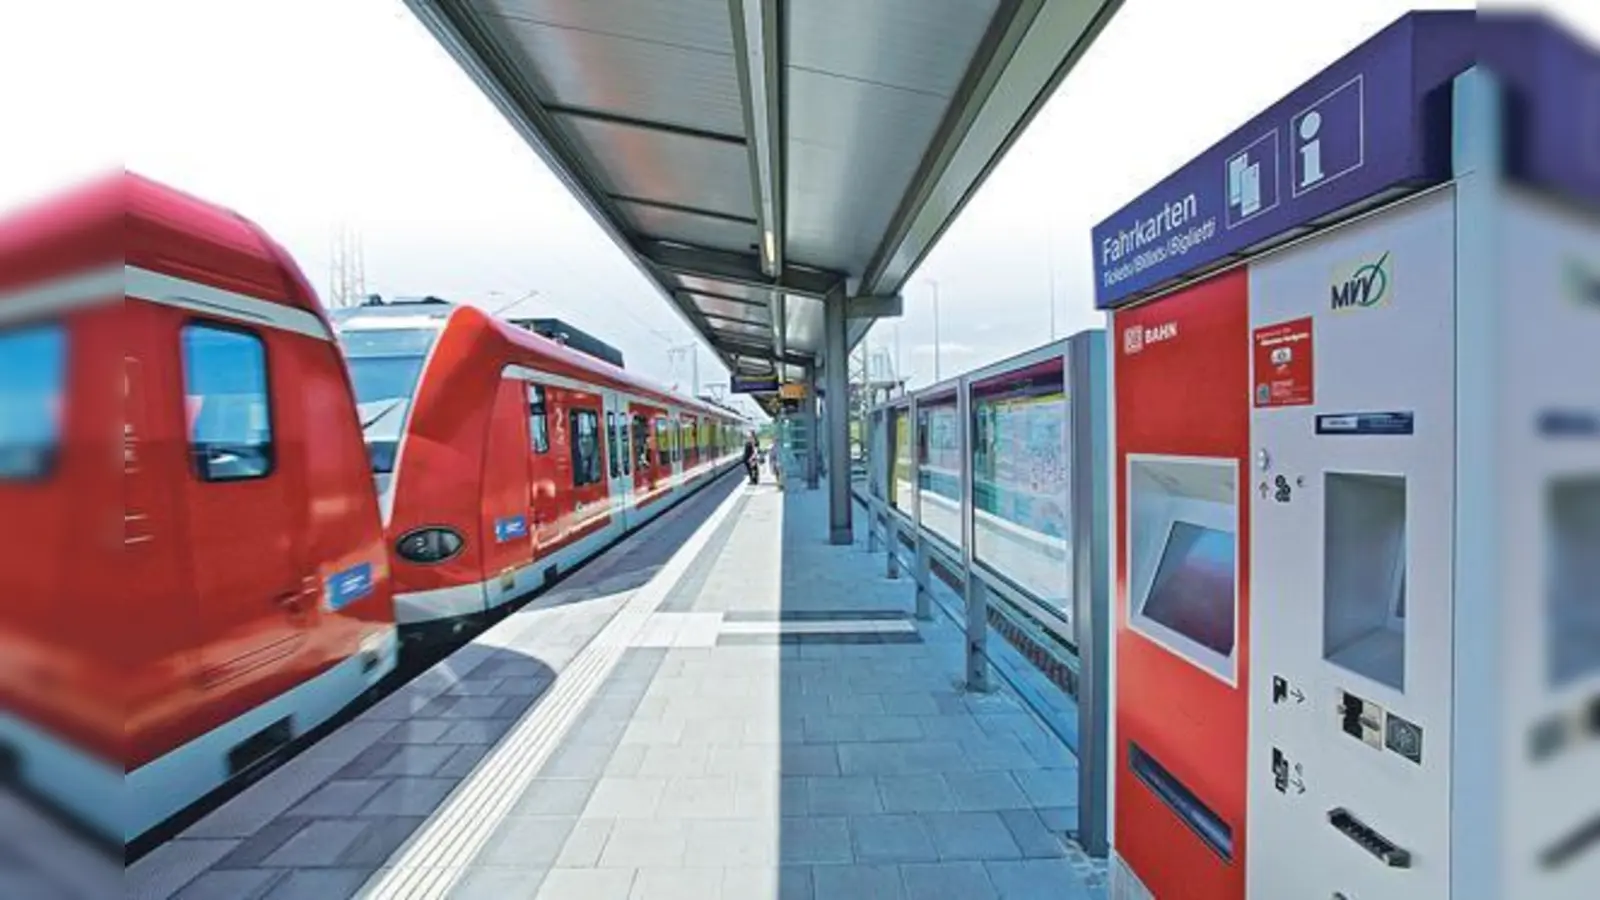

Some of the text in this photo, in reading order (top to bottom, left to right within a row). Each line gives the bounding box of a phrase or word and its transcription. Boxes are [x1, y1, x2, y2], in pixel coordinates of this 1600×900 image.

[1102, 193, 1197, 265] Fahrkarten
[1331, 250, 1389, 309] MVV
[1144, 321, 1178, 344] BAHN
